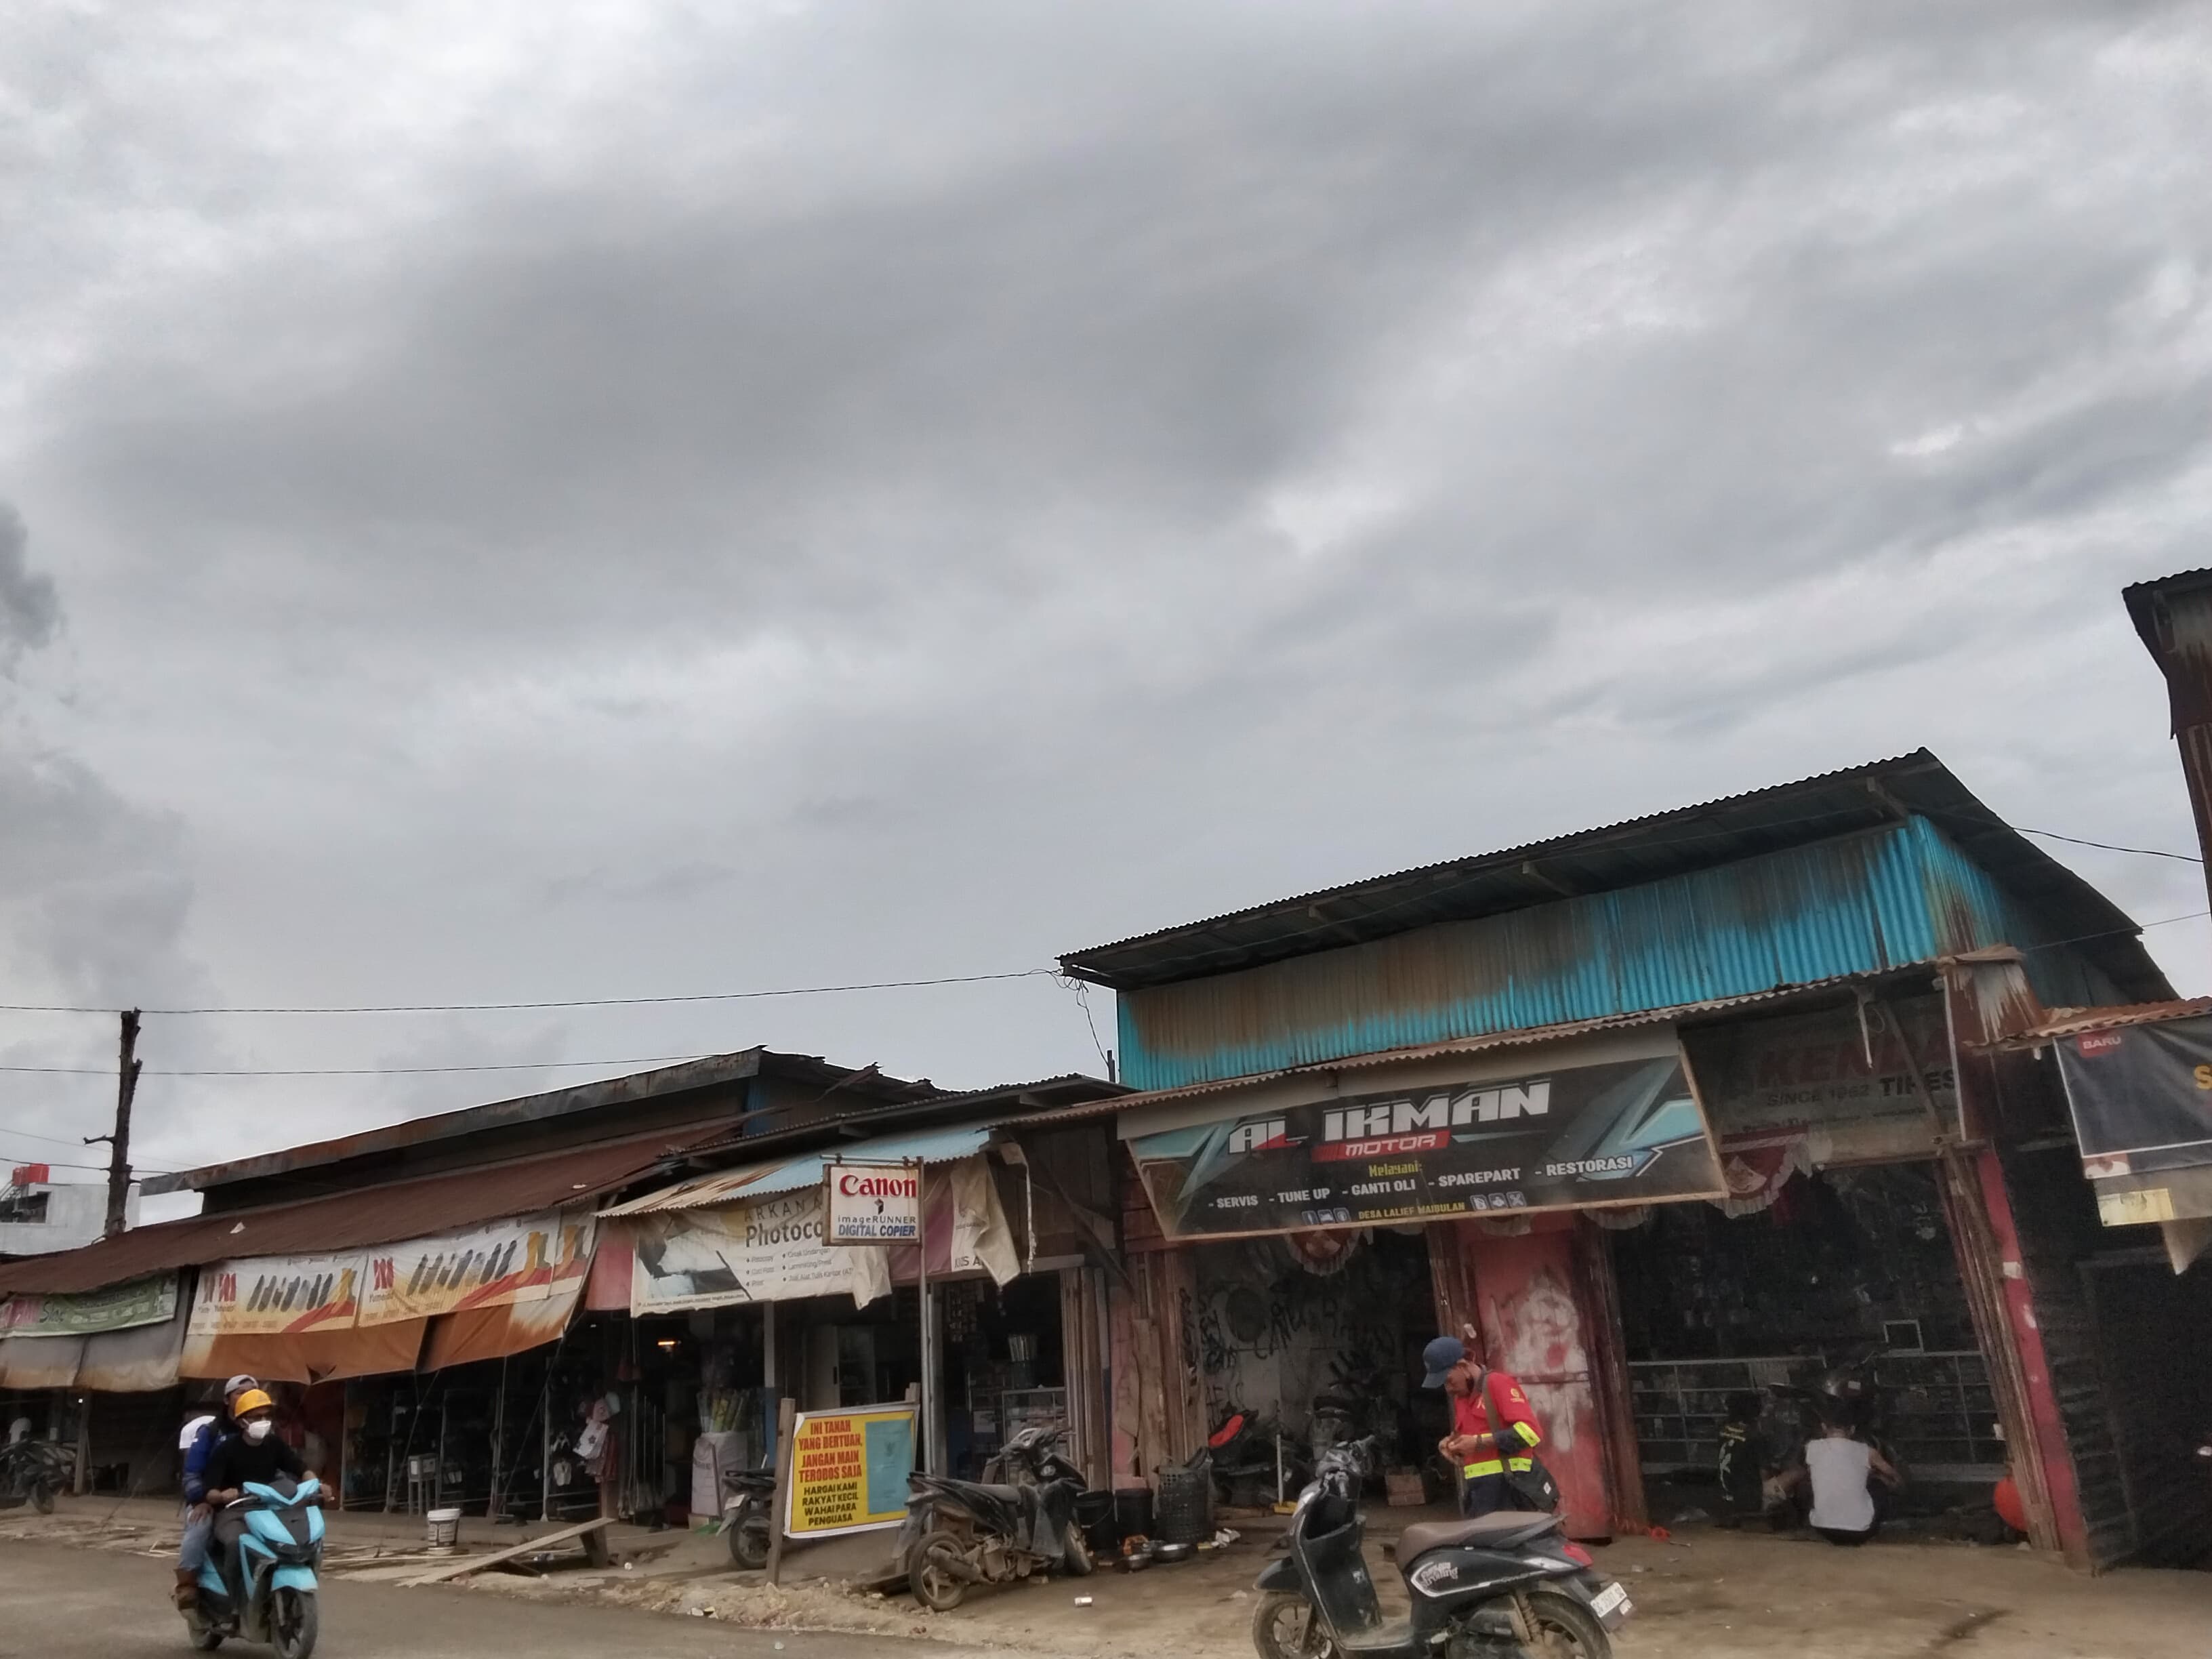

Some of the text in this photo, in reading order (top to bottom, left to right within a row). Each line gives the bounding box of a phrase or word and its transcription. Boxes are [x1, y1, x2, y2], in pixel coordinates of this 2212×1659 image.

[2083, 1036, 2122, 1050] BARU
[1229, 1081, 1550, 1154] AL IKMAN
[1345, 1134, 1437, 1157] MOTOR
[839, 1174, 916, 1197] Canon
[1216, 1195, 1258, 1208] SERVIS
[1277, 1189, 1310, 1204] TUNE
[1313, 1188, 1330, 1200] UP
[1351, 1183, 1391, 1196] GANTI
[1393, 1179, 1416, 1192] OLI
[1439, 1168, 1521, 1187] SPAREPART
[1546, 1156, 1633, 1176] RESTORASI
[838, 1215, 916, 1225] imageRUNNER
[1358, 1210, 1382, 1220] DESA
[838, 1225, 916, 1237] DIGITAL COPIER
[811, 1420, 851, 1435] INI TANAH
[798, 1437, 821, 1451] YANG
[802, 1450, 859, 1468] JANGAN MAIN
[798, 1465, 862, 1483] TEROBOS SAJA
[804, 1482, 857, 1496] HARGAI KAMI
[802, 1492, 859, 1507] RAKYAT KECIL
[804, 1503, 857, 1516] WAHAI PARA
[808, 1513, 853, 1526] PENGUASA
